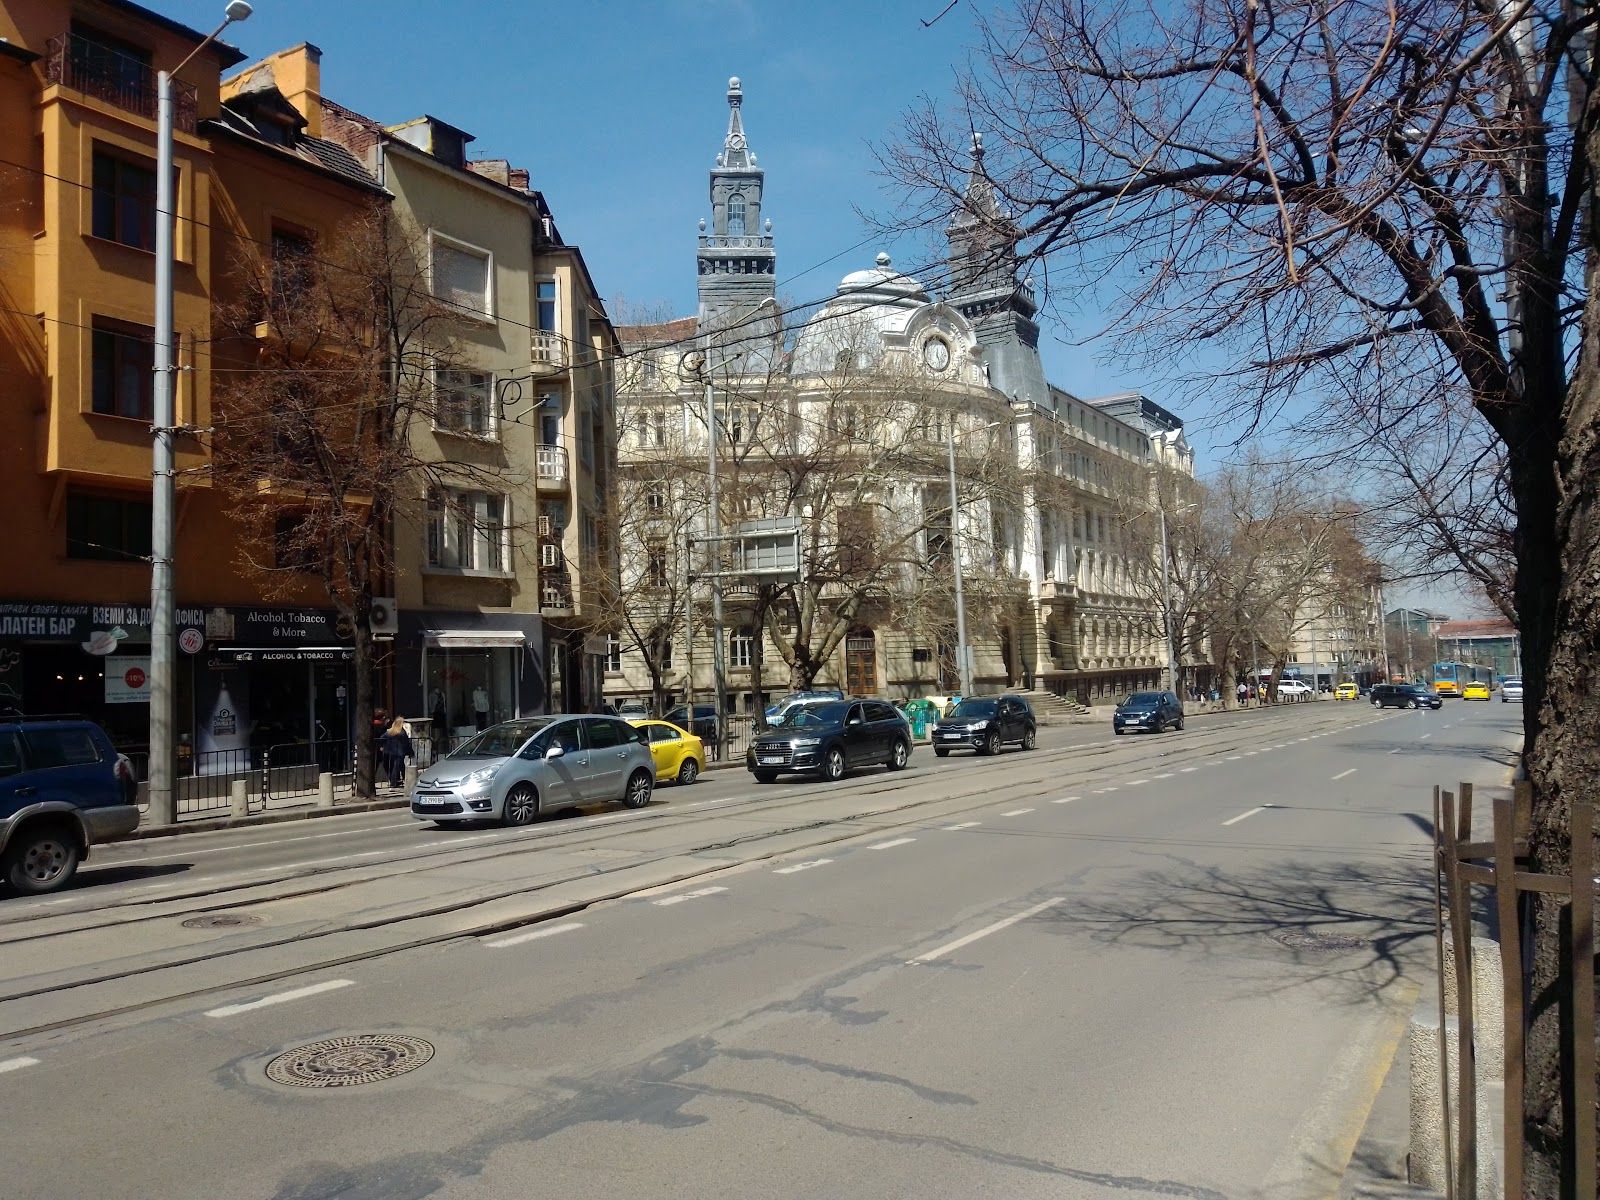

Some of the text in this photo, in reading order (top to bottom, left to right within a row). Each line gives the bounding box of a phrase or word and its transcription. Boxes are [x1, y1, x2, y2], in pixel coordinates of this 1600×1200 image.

[92, 606, 204, 627] ВЗЕМИ ЗА ДО ОФИСА
[288, 612, 327, 624] Tobacco
[0, 616, 76, 635] ЛАТЕН БАР
[272, 628, 307, 637] & More
[303, 652, 334, 660] TOBACCO
